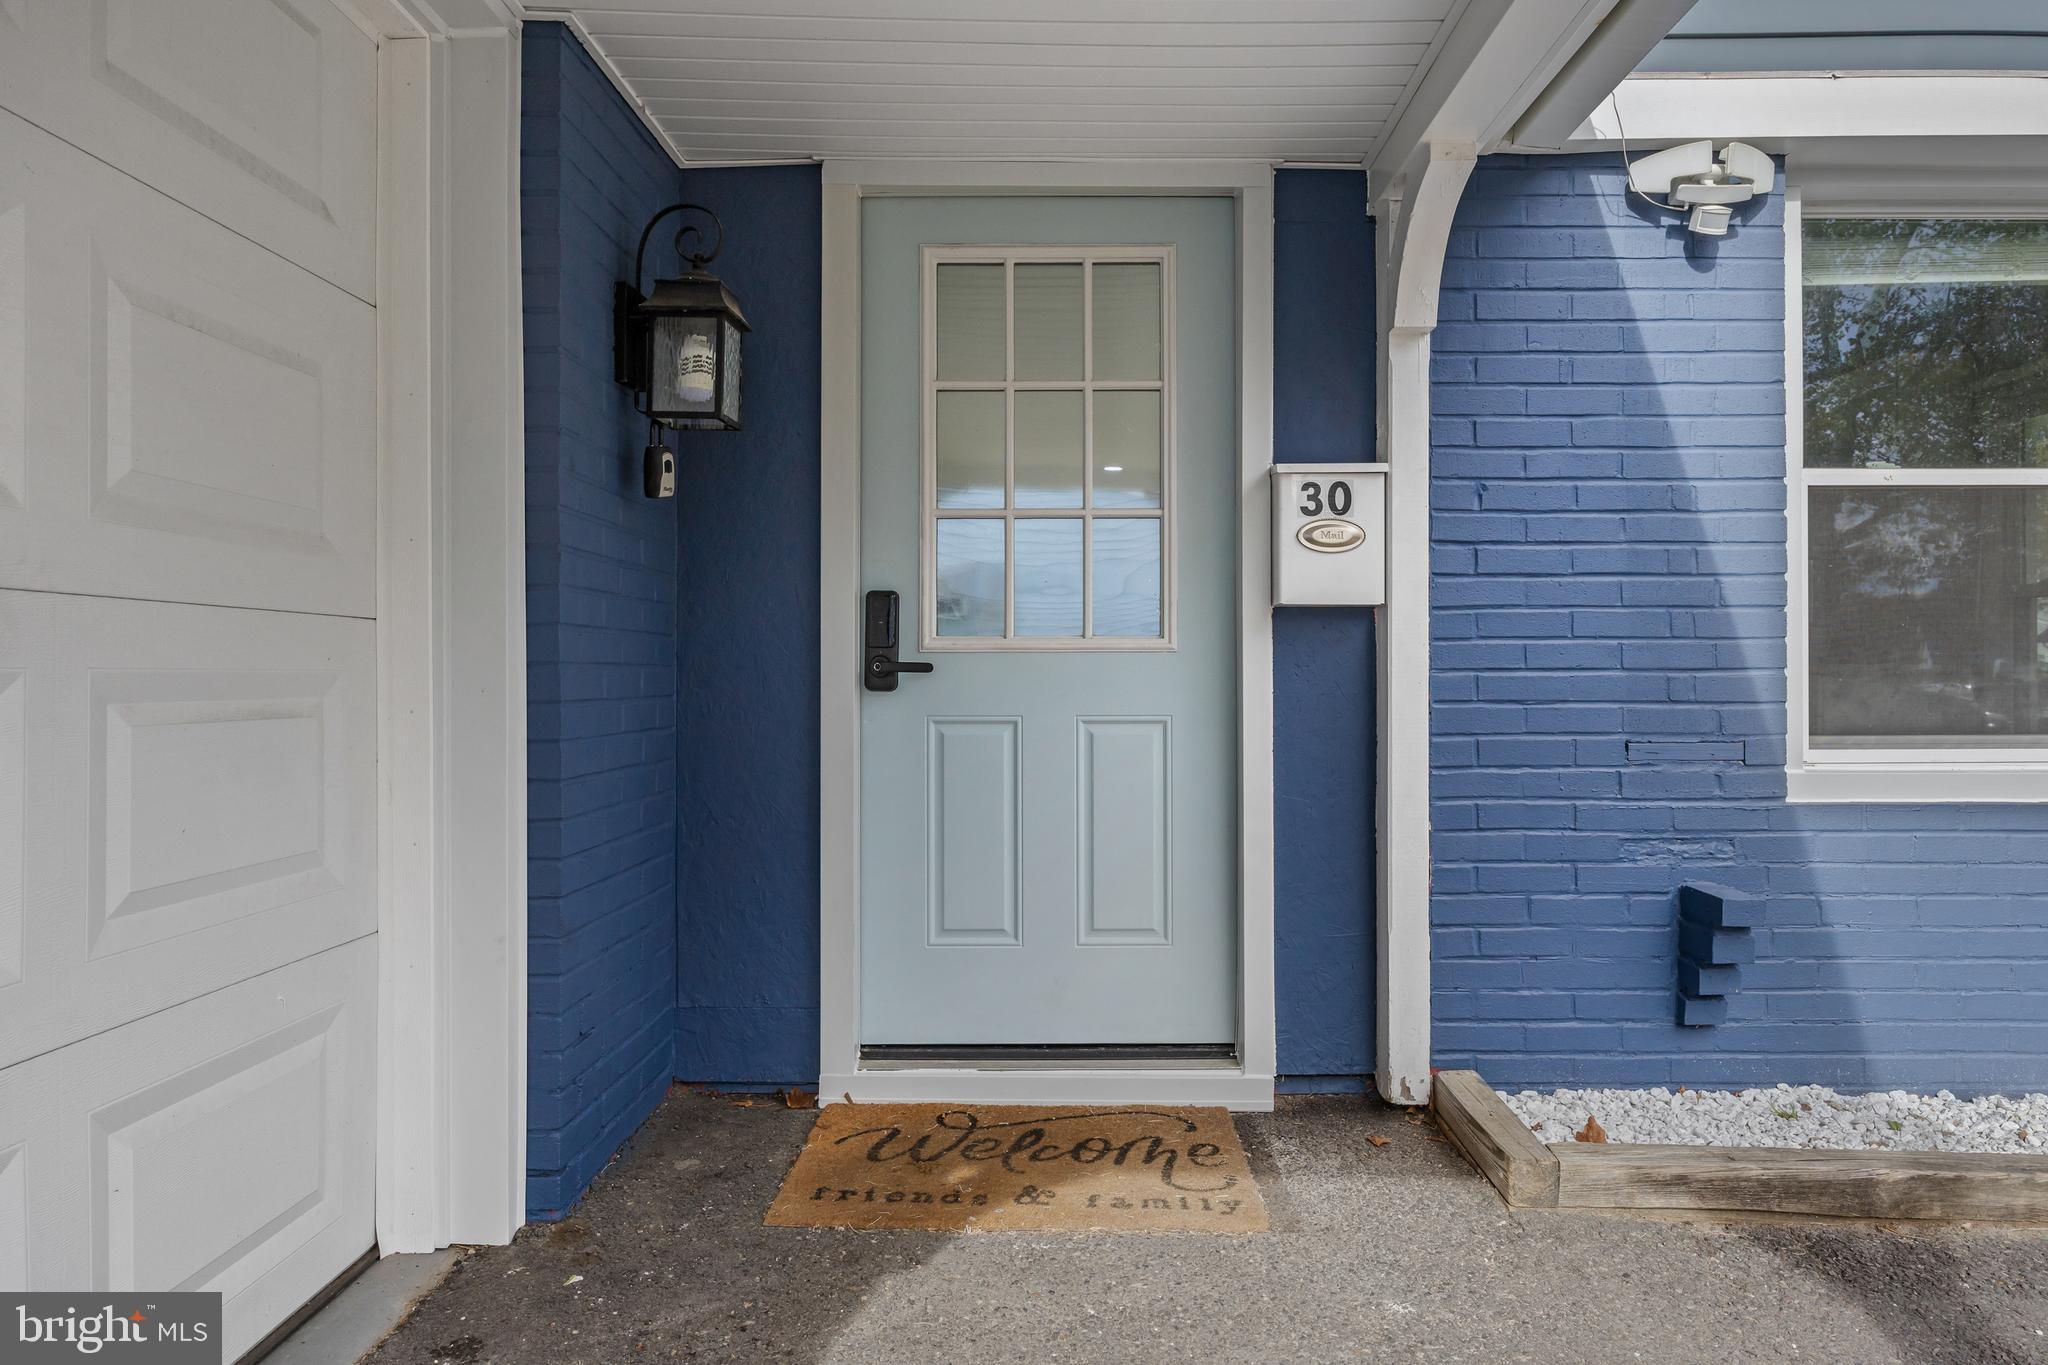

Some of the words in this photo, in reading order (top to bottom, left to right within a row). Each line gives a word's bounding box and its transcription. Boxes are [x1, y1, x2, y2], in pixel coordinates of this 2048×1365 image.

[1299, 480, 1353, 517] 30
[1320, 530, 1344, 540] Mail
[835, 1110, 1238, 1192] Welcome
[810, 1186, 988, 1206] friends
[1014, 1184, 1056, 1206] &
[1086, 1194, 1242, 1215] family
